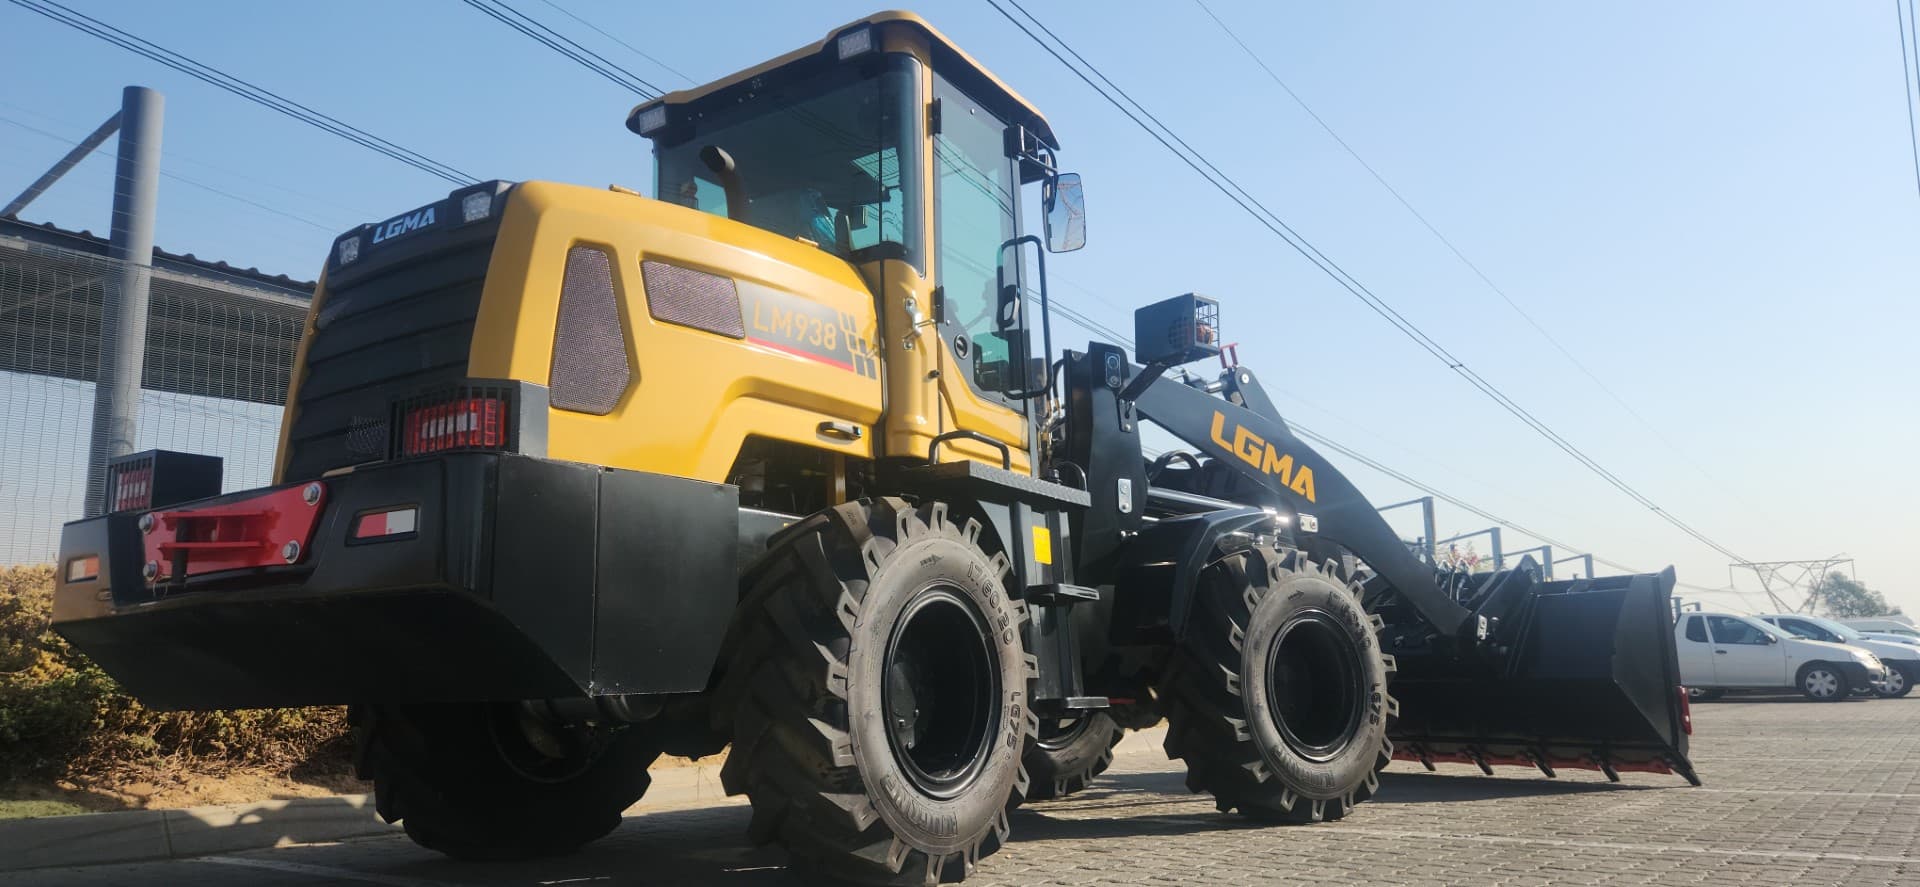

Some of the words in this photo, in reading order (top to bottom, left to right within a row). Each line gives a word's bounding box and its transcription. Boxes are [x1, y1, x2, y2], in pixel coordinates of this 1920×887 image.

[372, 207, 436, 244] LGMA
[752, 300, 837, 351] LM938
[1210, 410, 1316, 504] LGMA
[1007, 691, 1021, 750] LG75
